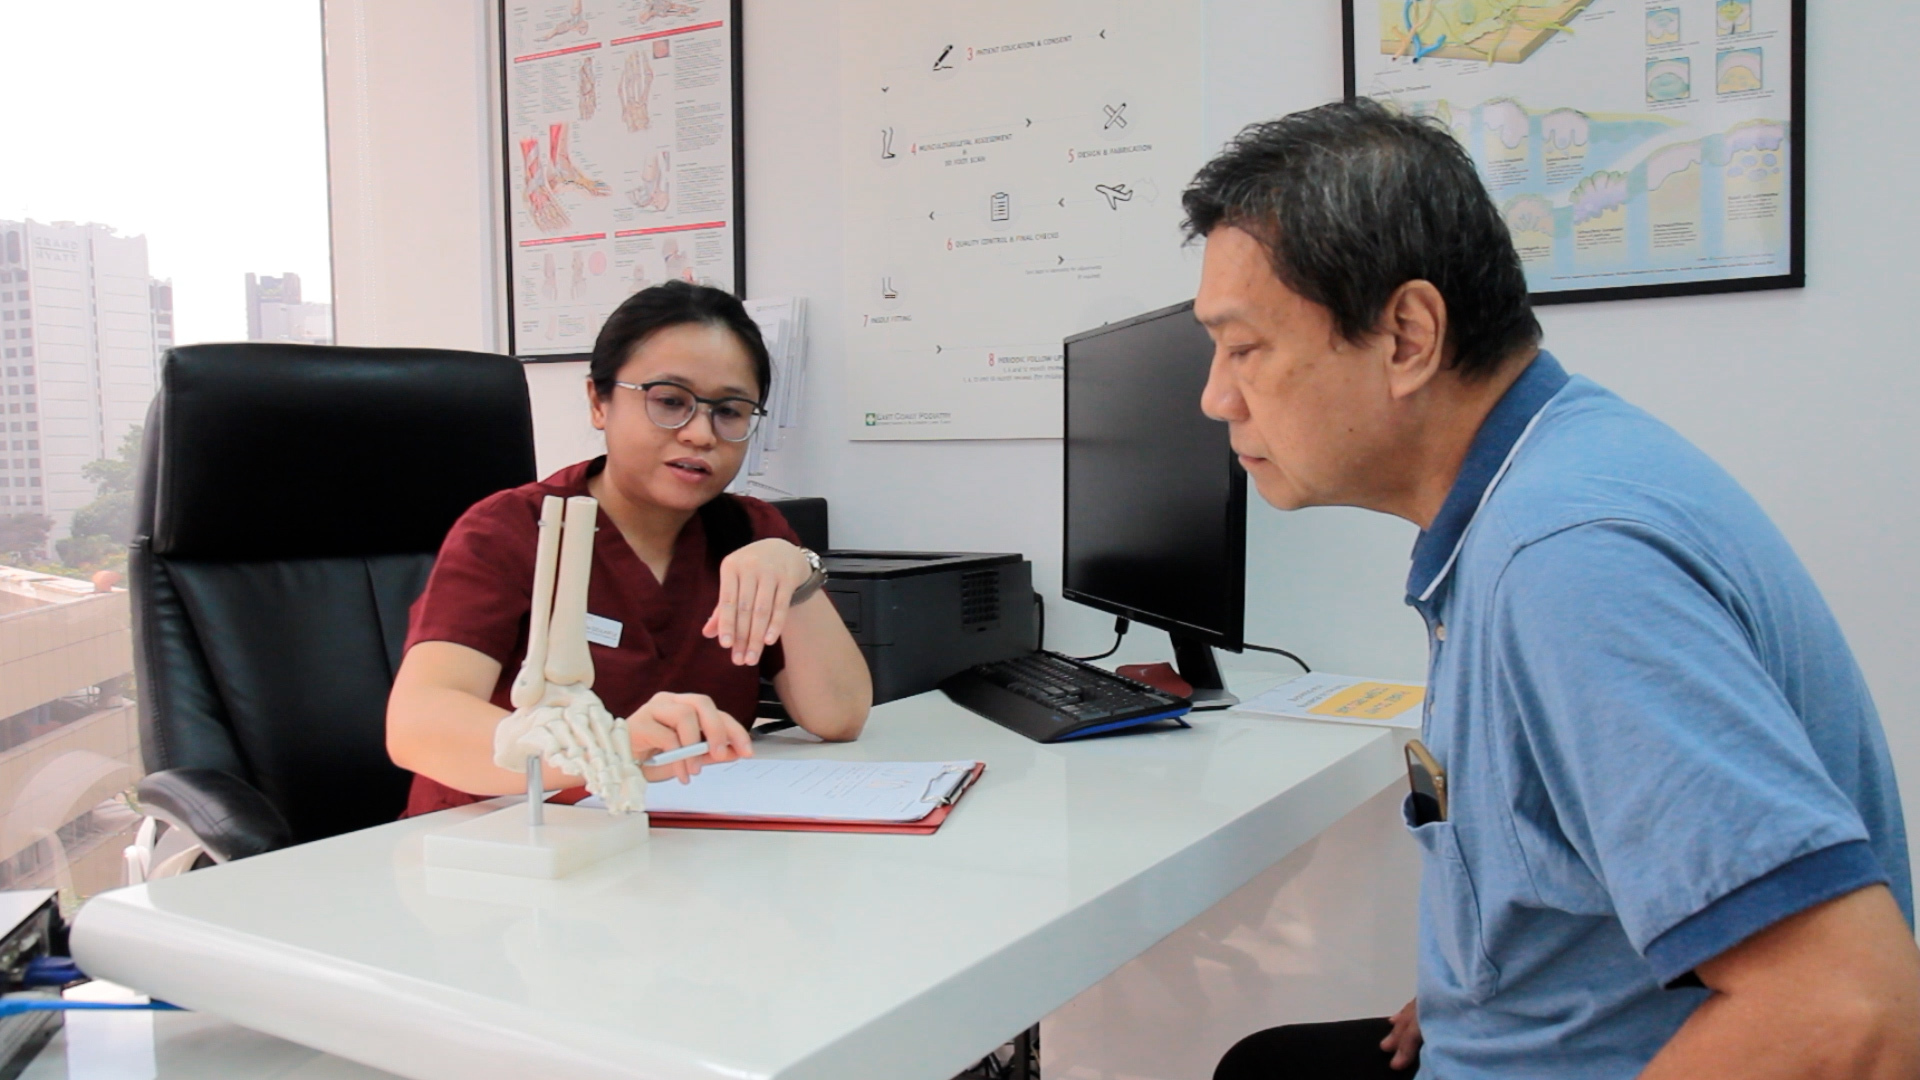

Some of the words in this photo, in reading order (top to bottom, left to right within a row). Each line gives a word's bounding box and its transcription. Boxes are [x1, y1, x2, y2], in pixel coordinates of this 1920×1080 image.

[967, 47, 973, 61] 3
[1001, 42, 1034, 52] EDUCATION
[1043, 35, 1072, 46] CONSENT
[910, 143, 917, 156] 4
[1068, 147, 1075, 163] 5
[1077, 150, 1101, 158] DESIGN
[1110, 144, 1152, 154] FABRICATION
[34, 236, 79, 250] GRAND
[947, 237, 953, 251] 6
[955, 239, 979, 248] QUALITY
[980, 237, 1007, 246] CONTROL
[1015, 234, 1033, 242] FINAL
[1034, 231, 1059, 240] CHECKS
[35, 250, 78, 262] HYATT
[863, 314, 868, 328] 7
[989, 353, 995, 367] 8
[1026, 355, 1051, 363] FOLLOW
